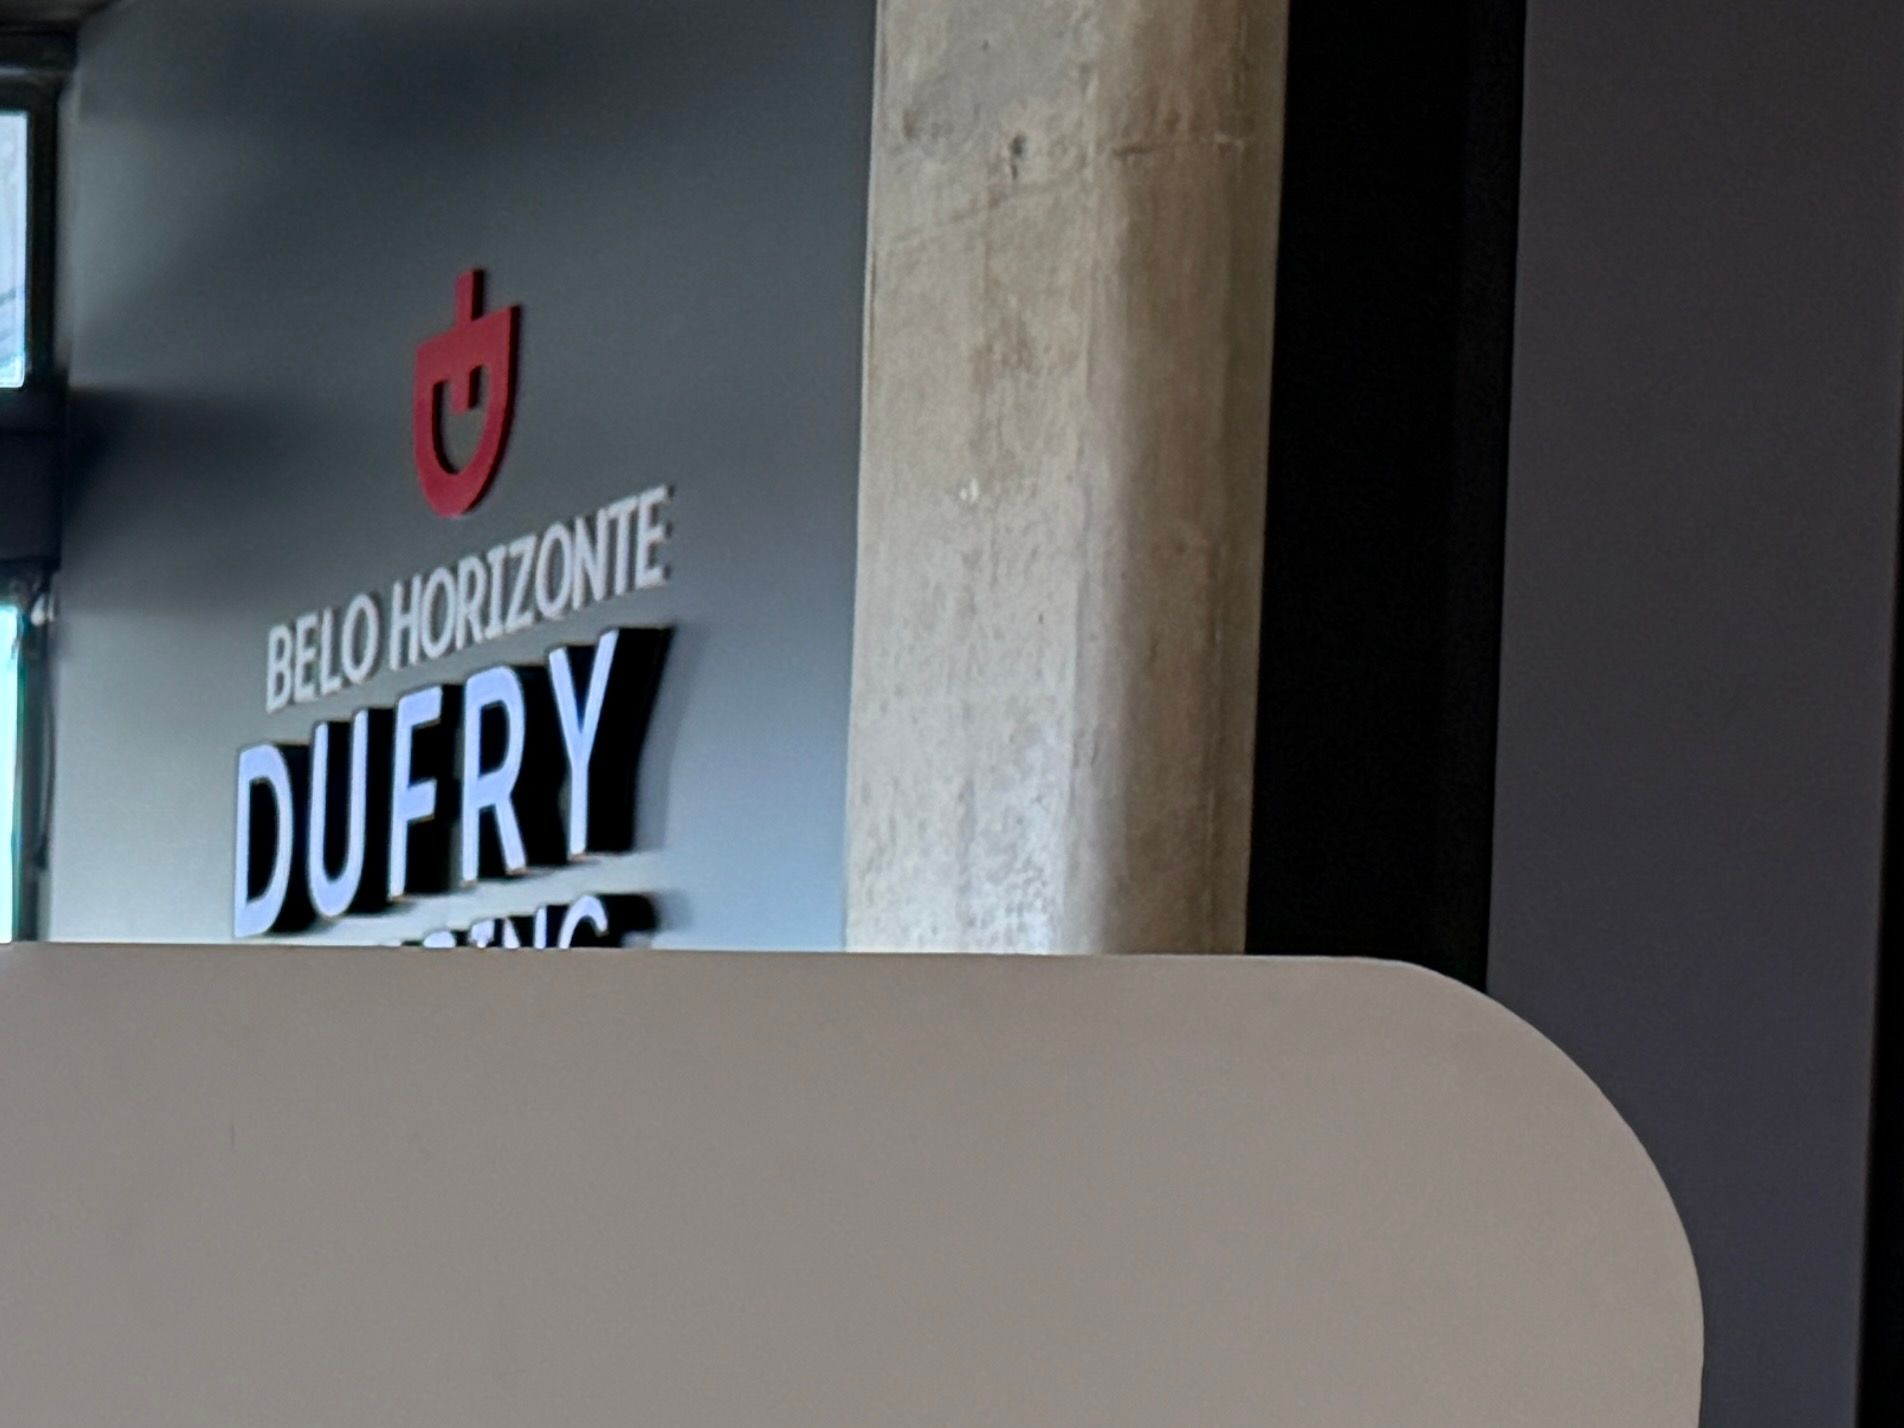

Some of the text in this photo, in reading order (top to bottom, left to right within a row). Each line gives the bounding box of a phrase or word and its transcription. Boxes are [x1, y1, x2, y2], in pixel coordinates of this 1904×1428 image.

[265, 485, 670, 713] BELO HORIZONTE
[234, 628, 622, 938] DUFRY
